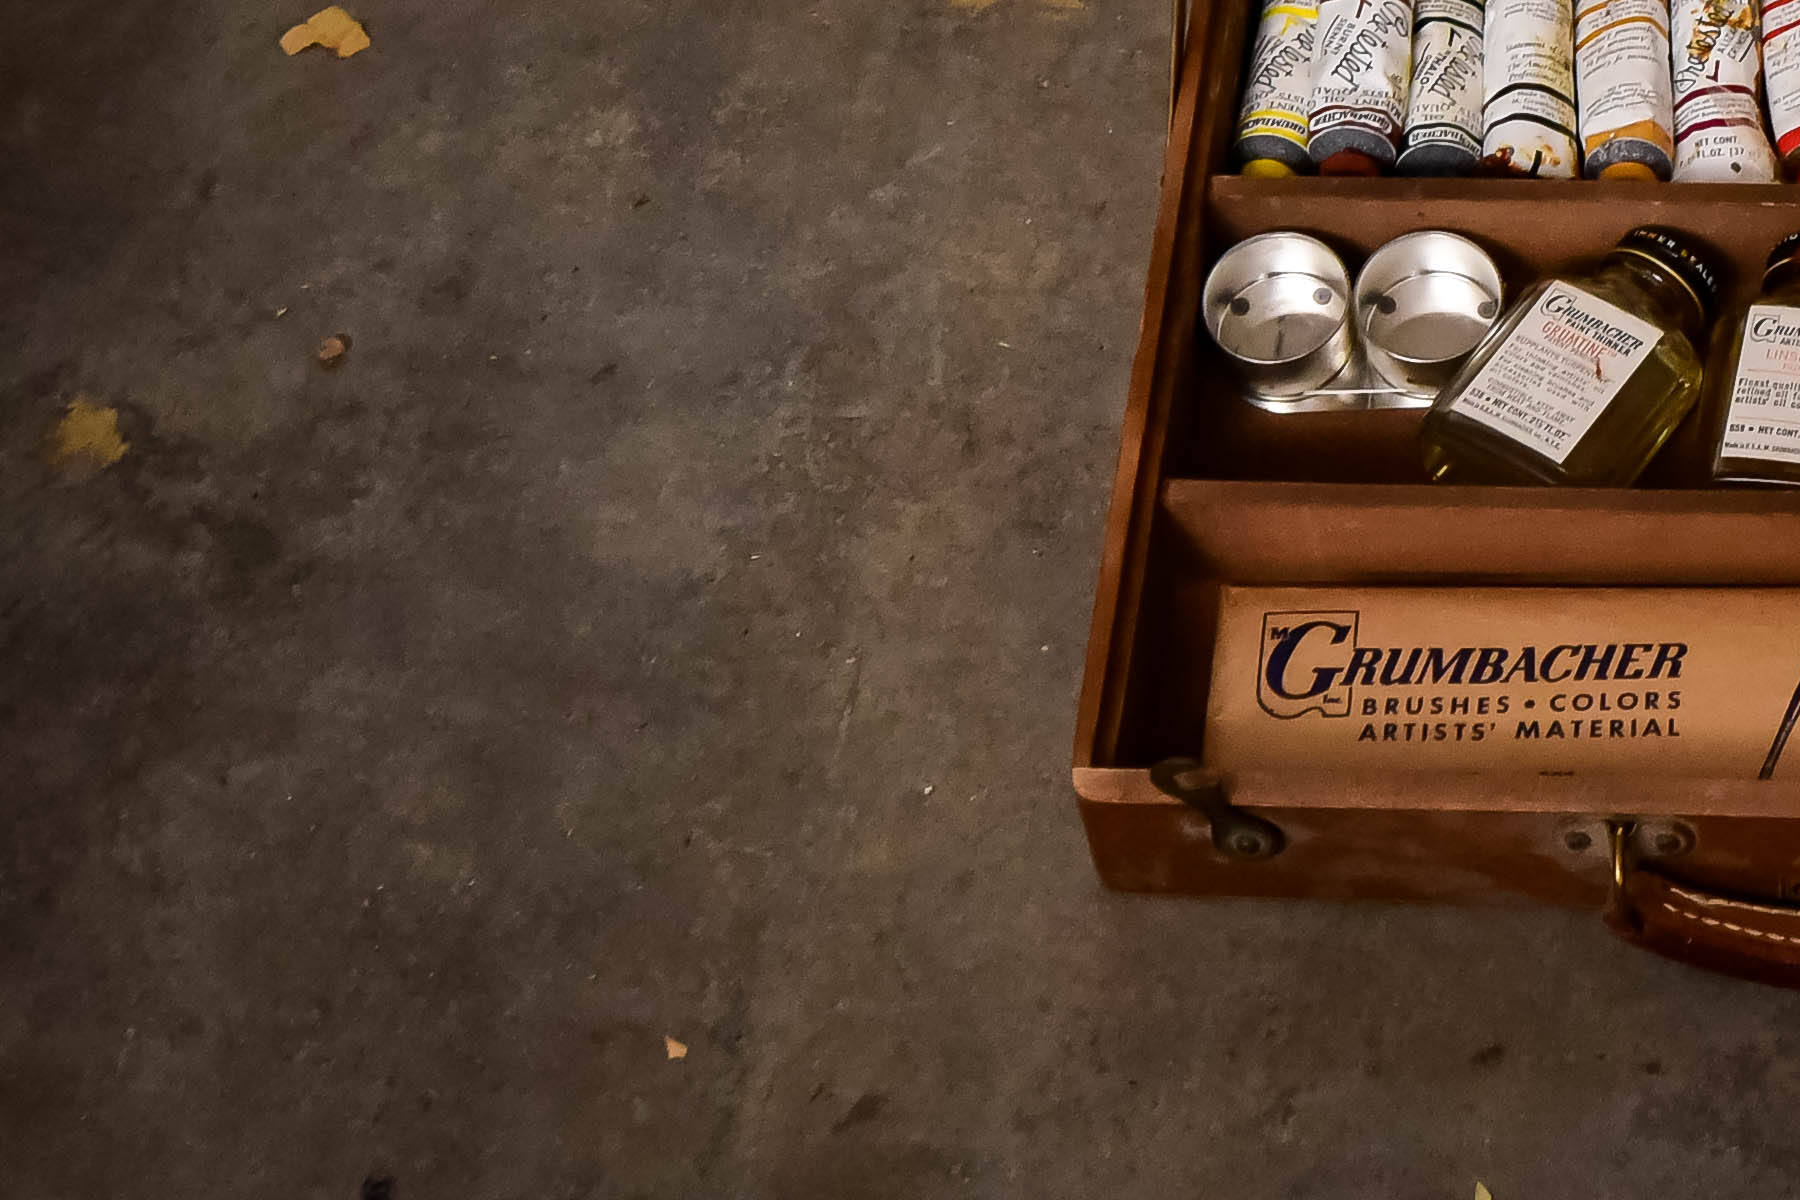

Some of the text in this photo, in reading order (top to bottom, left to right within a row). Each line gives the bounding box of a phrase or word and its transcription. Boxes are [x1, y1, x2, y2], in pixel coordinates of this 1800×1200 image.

[1545, 294, 1645, 352] GRUMBACHER
[1564, 319, 1632, 357] PAINT THINNER
[1736, 387, 1772, 397] refined
[1775, 390, 1788, 399] oil
[1738, 378, 1770, 387] Finest
[1491, 398, 1530, 422] NET CONT.
[1773, 399, 1787, 408] oil
[1757, 425, 1774, 435] NET
[1775, 427, 1800, 440] CONT.
[1265, 620, 1689, 700] GRUMBACHER
[1362, 690, 1682, 716] BRUSHES COLORS
[1358, 718, 1681, 742] ARTISTS' MATERIAL
